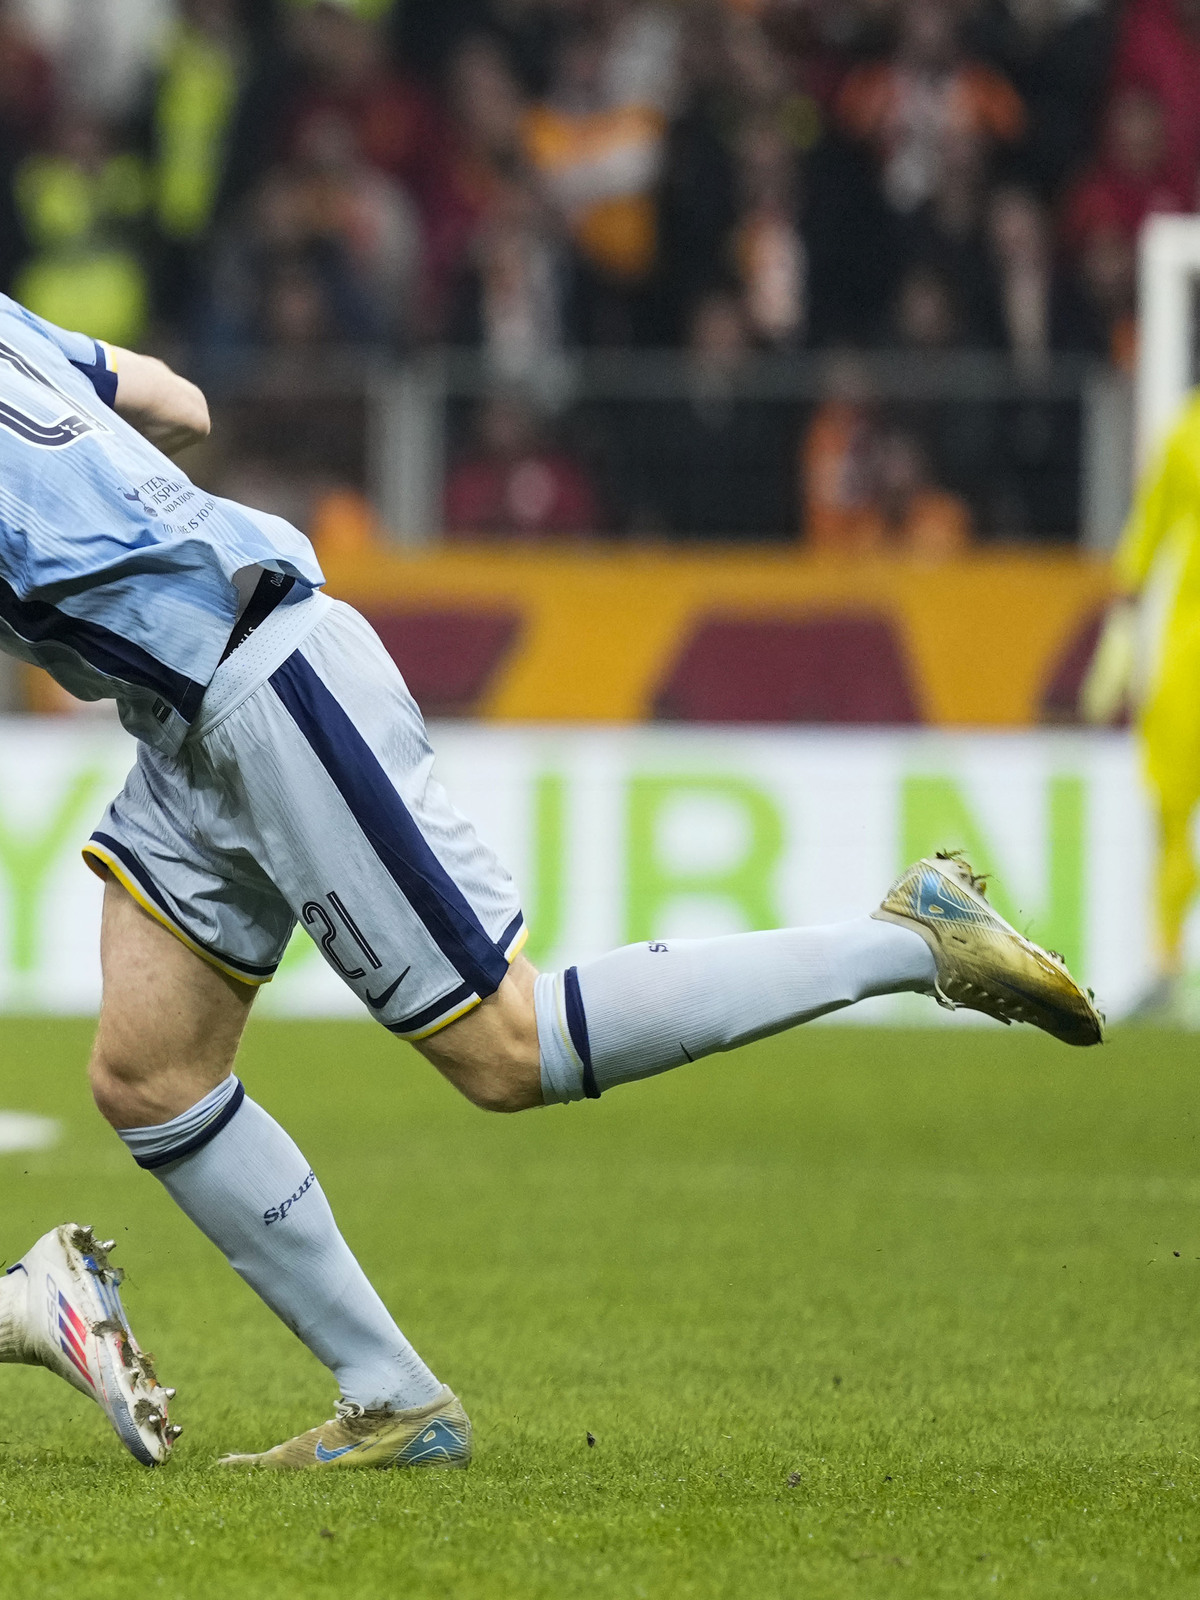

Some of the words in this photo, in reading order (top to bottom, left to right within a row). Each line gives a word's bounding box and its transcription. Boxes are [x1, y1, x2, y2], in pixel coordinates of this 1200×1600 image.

[188, 519, 199, 530] IS
[196, 508, 209, 521] TO
[302, 891, 382, 979] 21
[263, 1169, 315, 1226] Spurs
